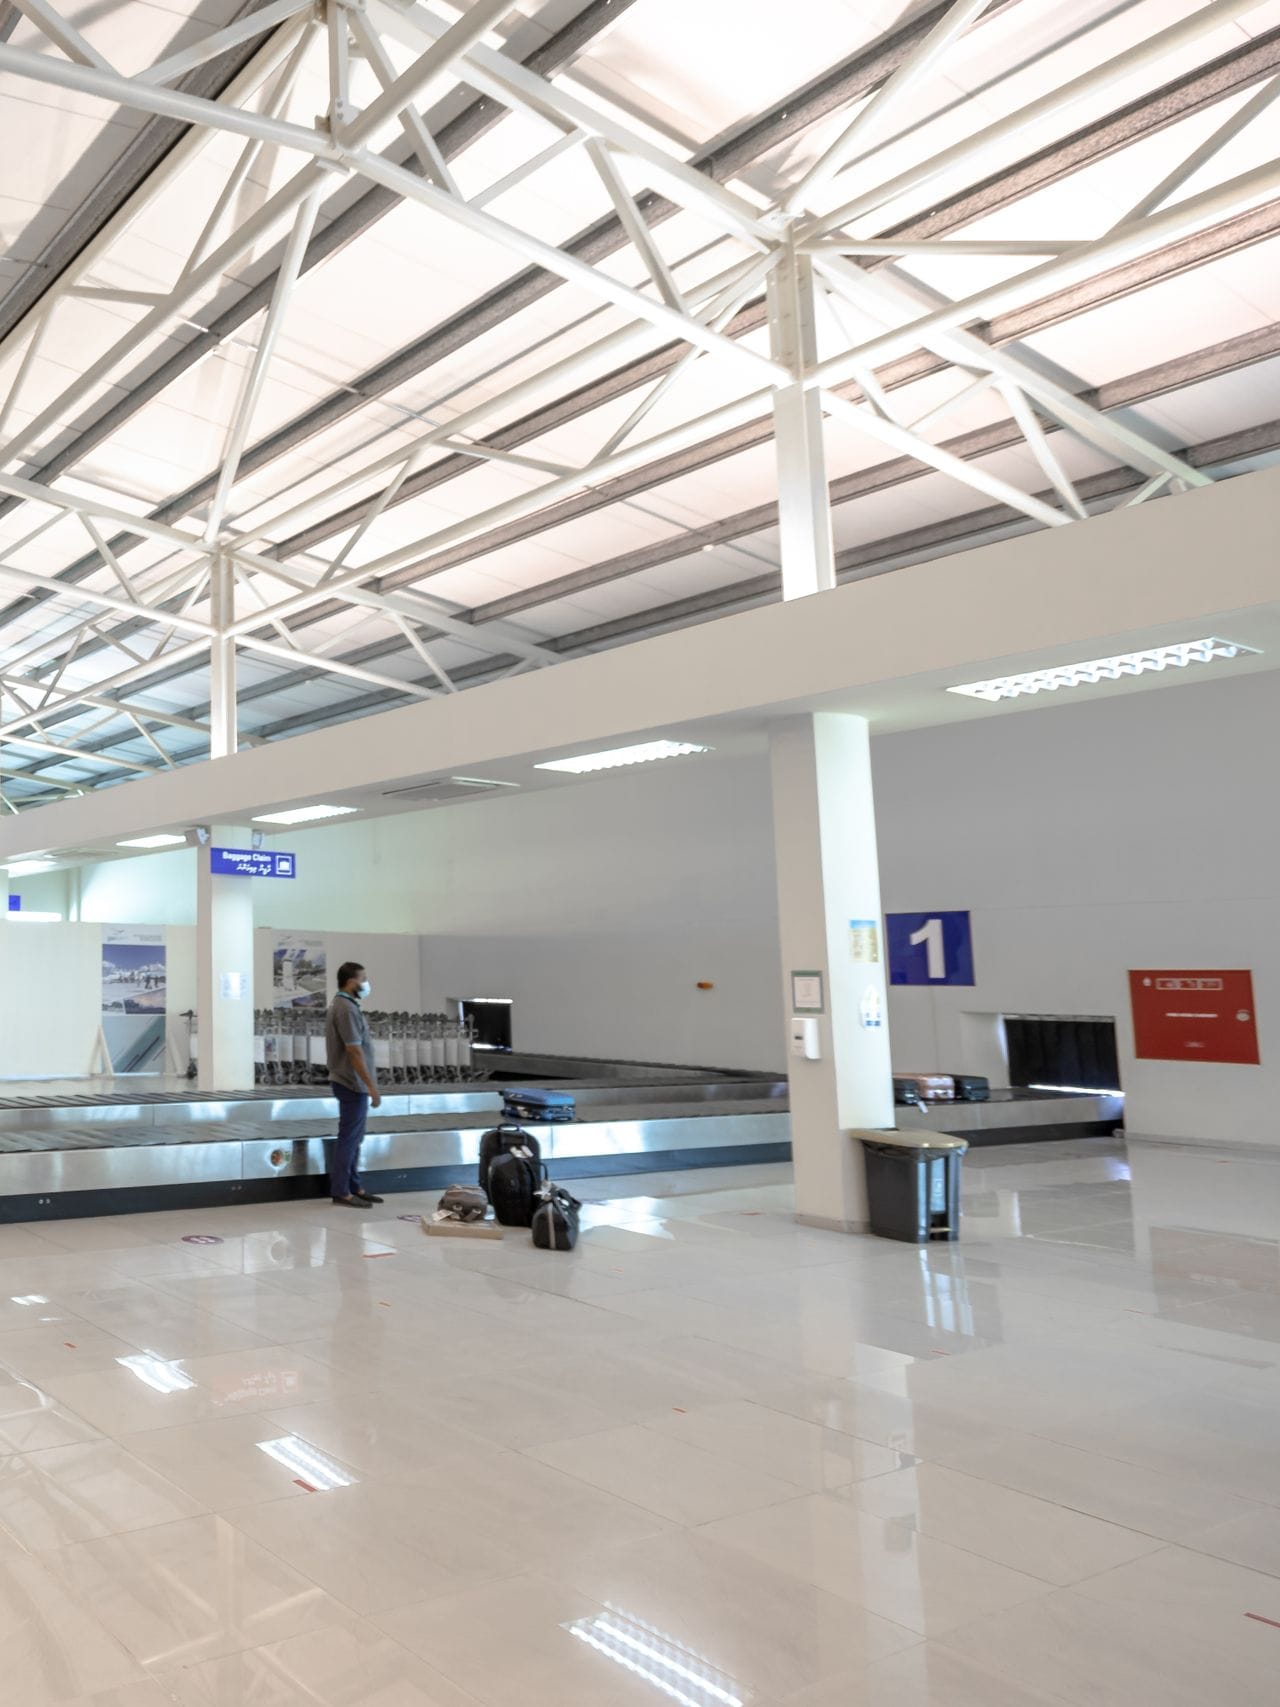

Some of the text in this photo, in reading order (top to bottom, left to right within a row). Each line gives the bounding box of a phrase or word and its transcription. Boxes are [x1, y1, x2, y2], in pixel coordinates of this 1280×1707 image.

[222, 851, 272, 862] Baggage Claim
[910, 918, 946, 979] 1
